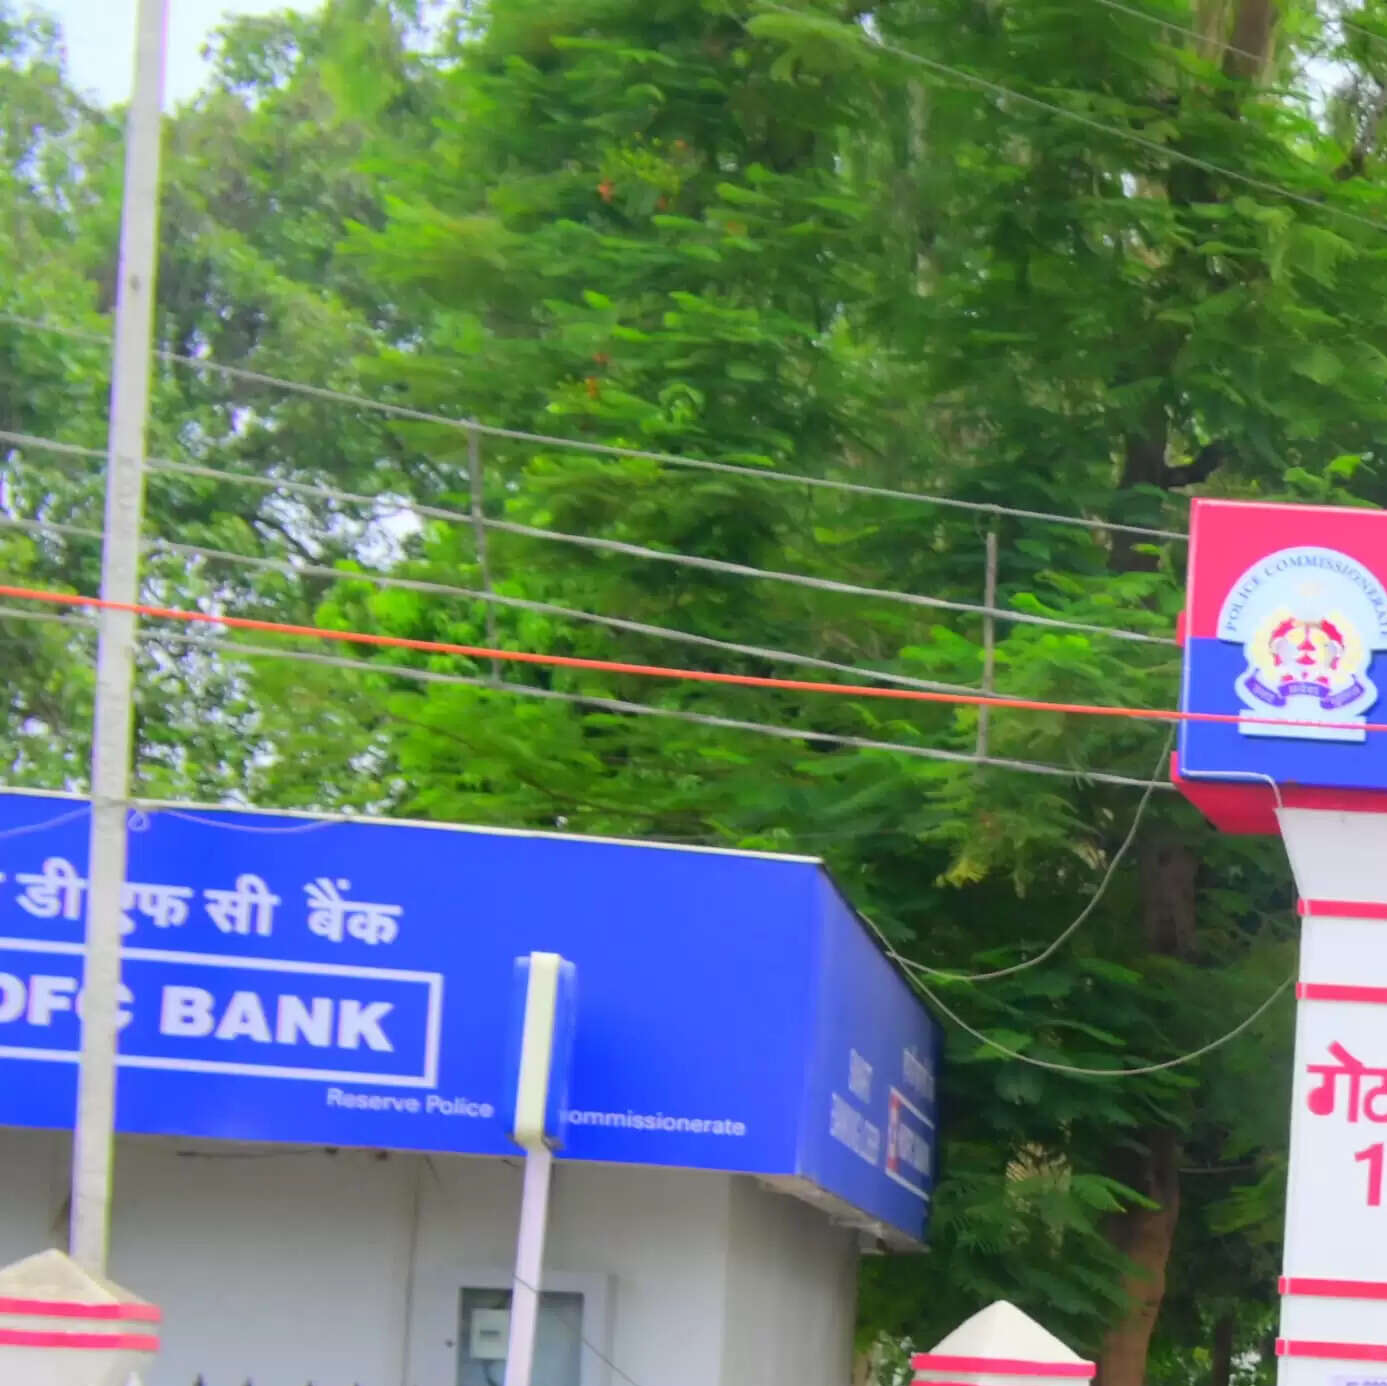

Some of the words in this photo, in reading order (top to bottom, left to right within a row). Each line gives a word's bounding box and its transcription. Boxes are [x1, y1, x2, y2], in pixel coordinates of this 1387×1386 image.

[203, 873, 281, 937] सी
[303, 877, 403, 945] बैंक
[160, 984, 396, 1053] BANK
[326, 1087, 420, 1115] Reserve
[425, 1095, 495, 1119] Police
[563, 1107, 747, 1137] ommissionerate
[1353, 1142, 1385, 1206] 1
